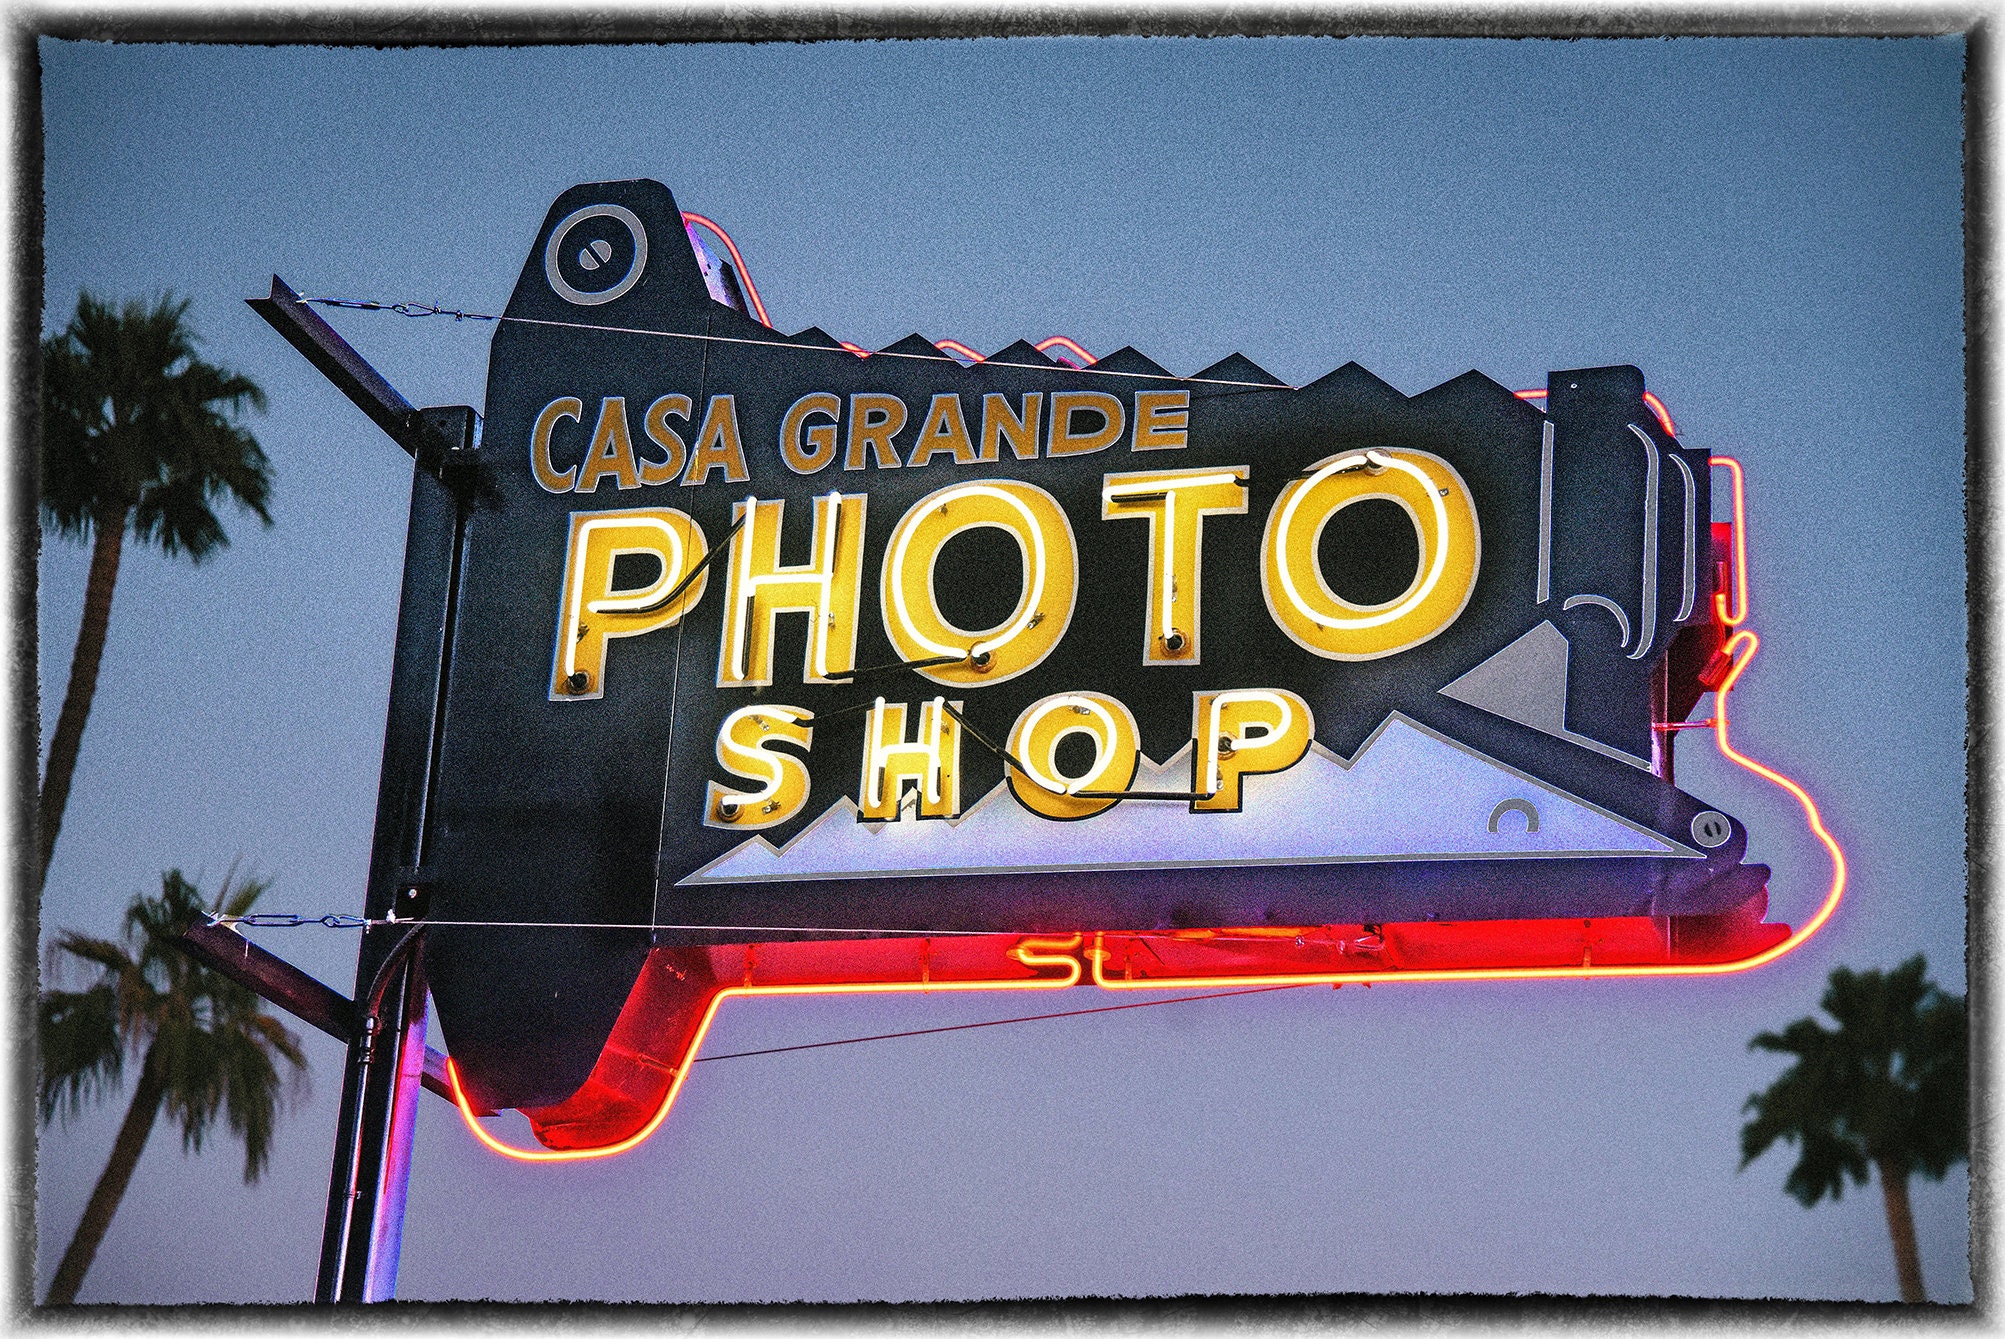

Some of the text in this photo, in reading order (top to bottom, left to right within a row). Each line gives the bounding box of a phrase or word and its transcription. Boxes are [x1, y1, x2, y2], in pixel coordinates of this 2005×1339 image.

[530, 390, 1191, 494] CASA GRANDE
[548, 446, 1482, 702] PHOTO
[703, 688, 1316, 830] SHOP
